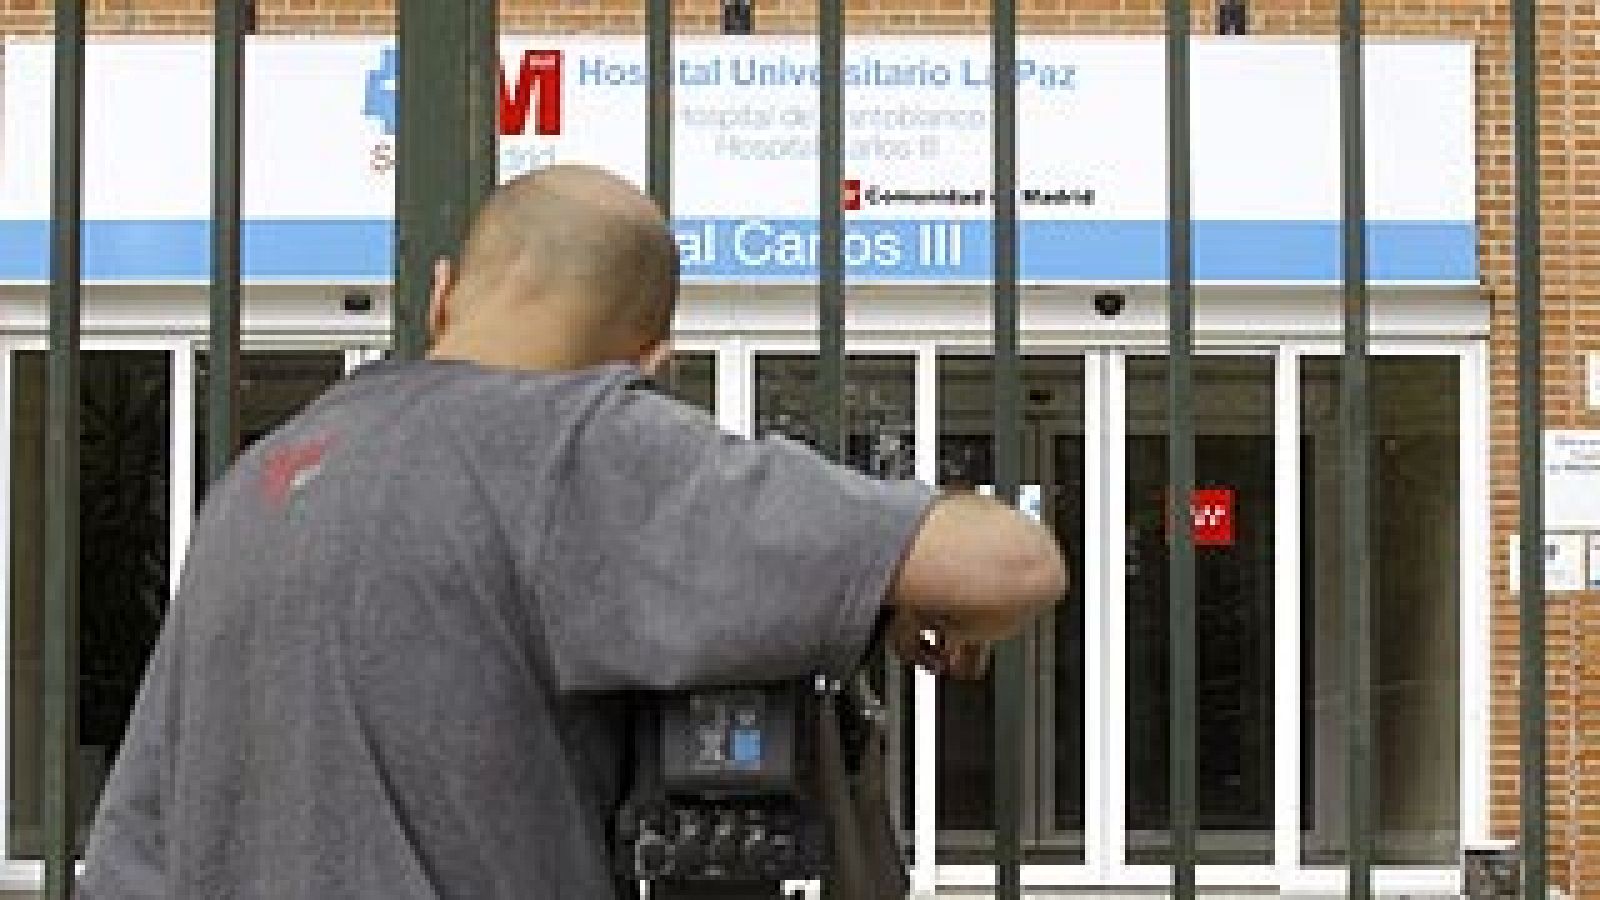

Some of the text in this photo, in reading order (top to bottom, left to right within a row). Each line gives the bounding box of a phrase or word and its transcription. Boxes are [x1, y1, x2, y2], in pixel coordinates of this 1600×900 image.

[579, 57, 721, 86] Hostal
[733, 57, 950, 87] Univesitario
[849, 135, 912, 159] arlos
[864, 184, 986, 206] Comunidad
[1023, 187, 1096, 206] Madrid
[733, 220, 901, 267] Caros
[918, 222, 963, 268] III
